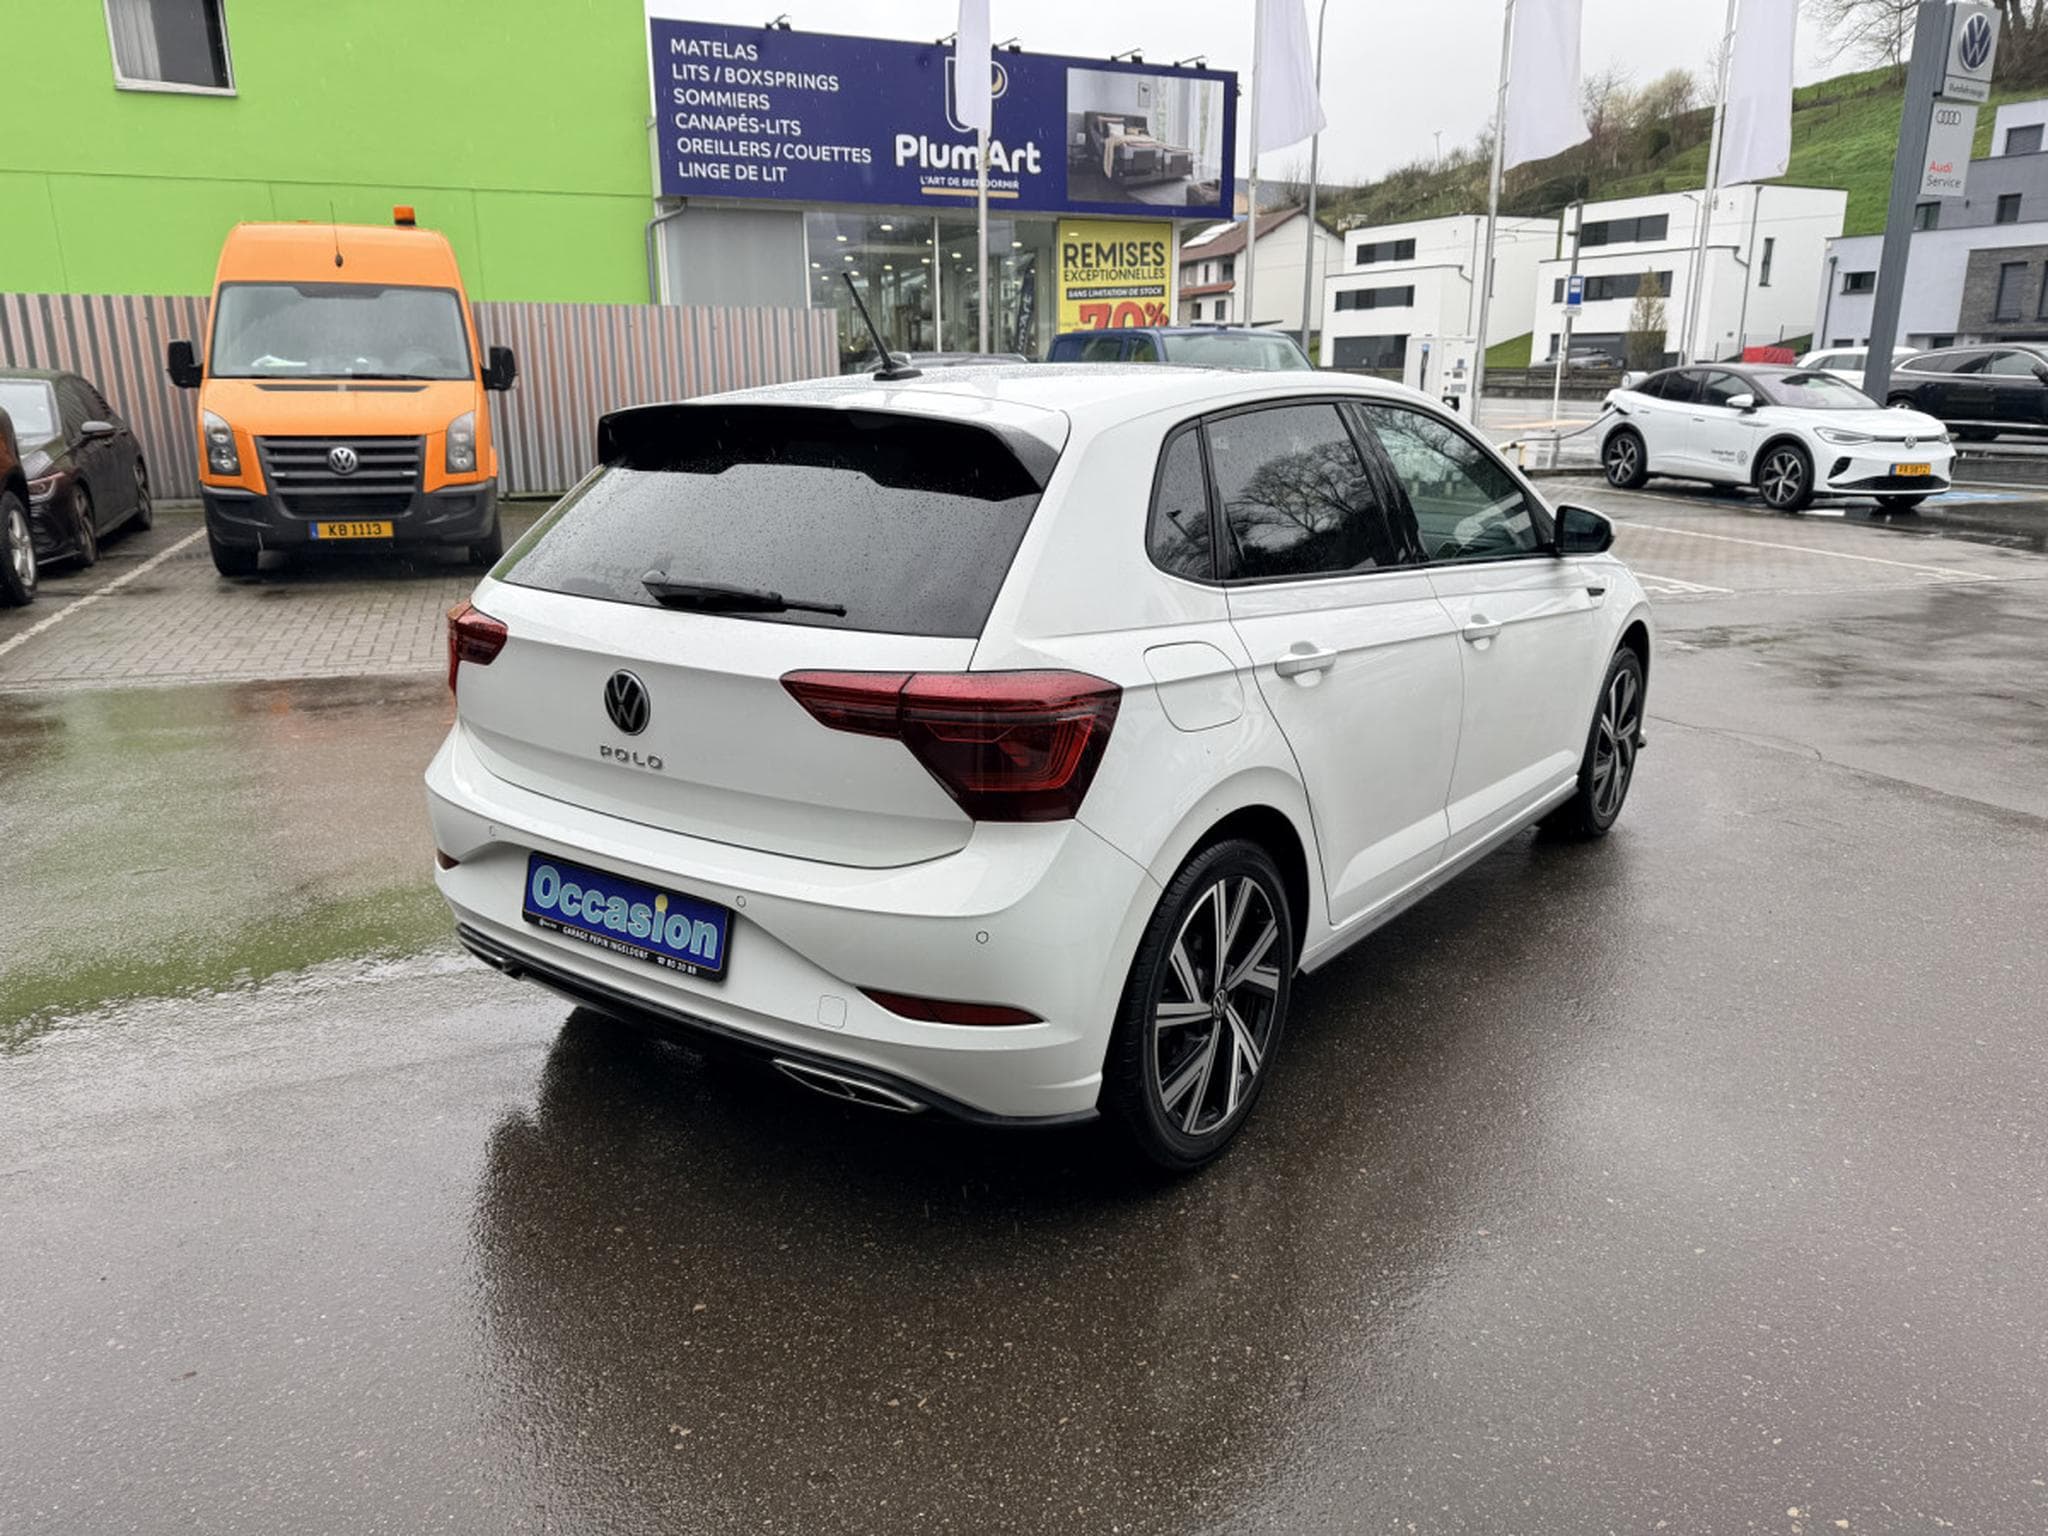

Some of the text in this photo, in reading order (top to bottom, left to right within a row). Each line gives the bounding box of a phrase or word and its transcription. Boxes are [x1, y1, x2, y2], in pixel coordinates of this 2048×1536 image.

[671, 38, 758, 61] MATELAS
[672, 63, 710, 82] LITS
[725, 67, 840, 92] BOXSPRINGS
[673, 88, 770, 110] SOMMIERS
[675, 112, 801, 136] CANAPÉS-LITS
[677, 137, 771, 158] OREILLERS
[783, 144, 872, 164] COUETTES
[895, 134, 1042, 174] PlumArt
[678, 161, 787, 182] LINGE DE LIT
[1928, 161, 1953, 173] Audi
[962, 178, 980, 188] BIE
[1926, 174, 1961, 188] Service
[1063, 241, 1165, 268] REMISES
[1064, 268, 1166, 281] EXCEPTIONNELLES
[1068, 290, 1087, 298] SANS
[1129, 288, 1138, 296] DE
[1140, 286, 1163, 296] STOCK
[328, 522, 382, 536] KB 1113
[600, 745, 663, 770] POLO
[532, 865, 718, 960] Occasion
[562, 926, 588, 941] GARAGE
